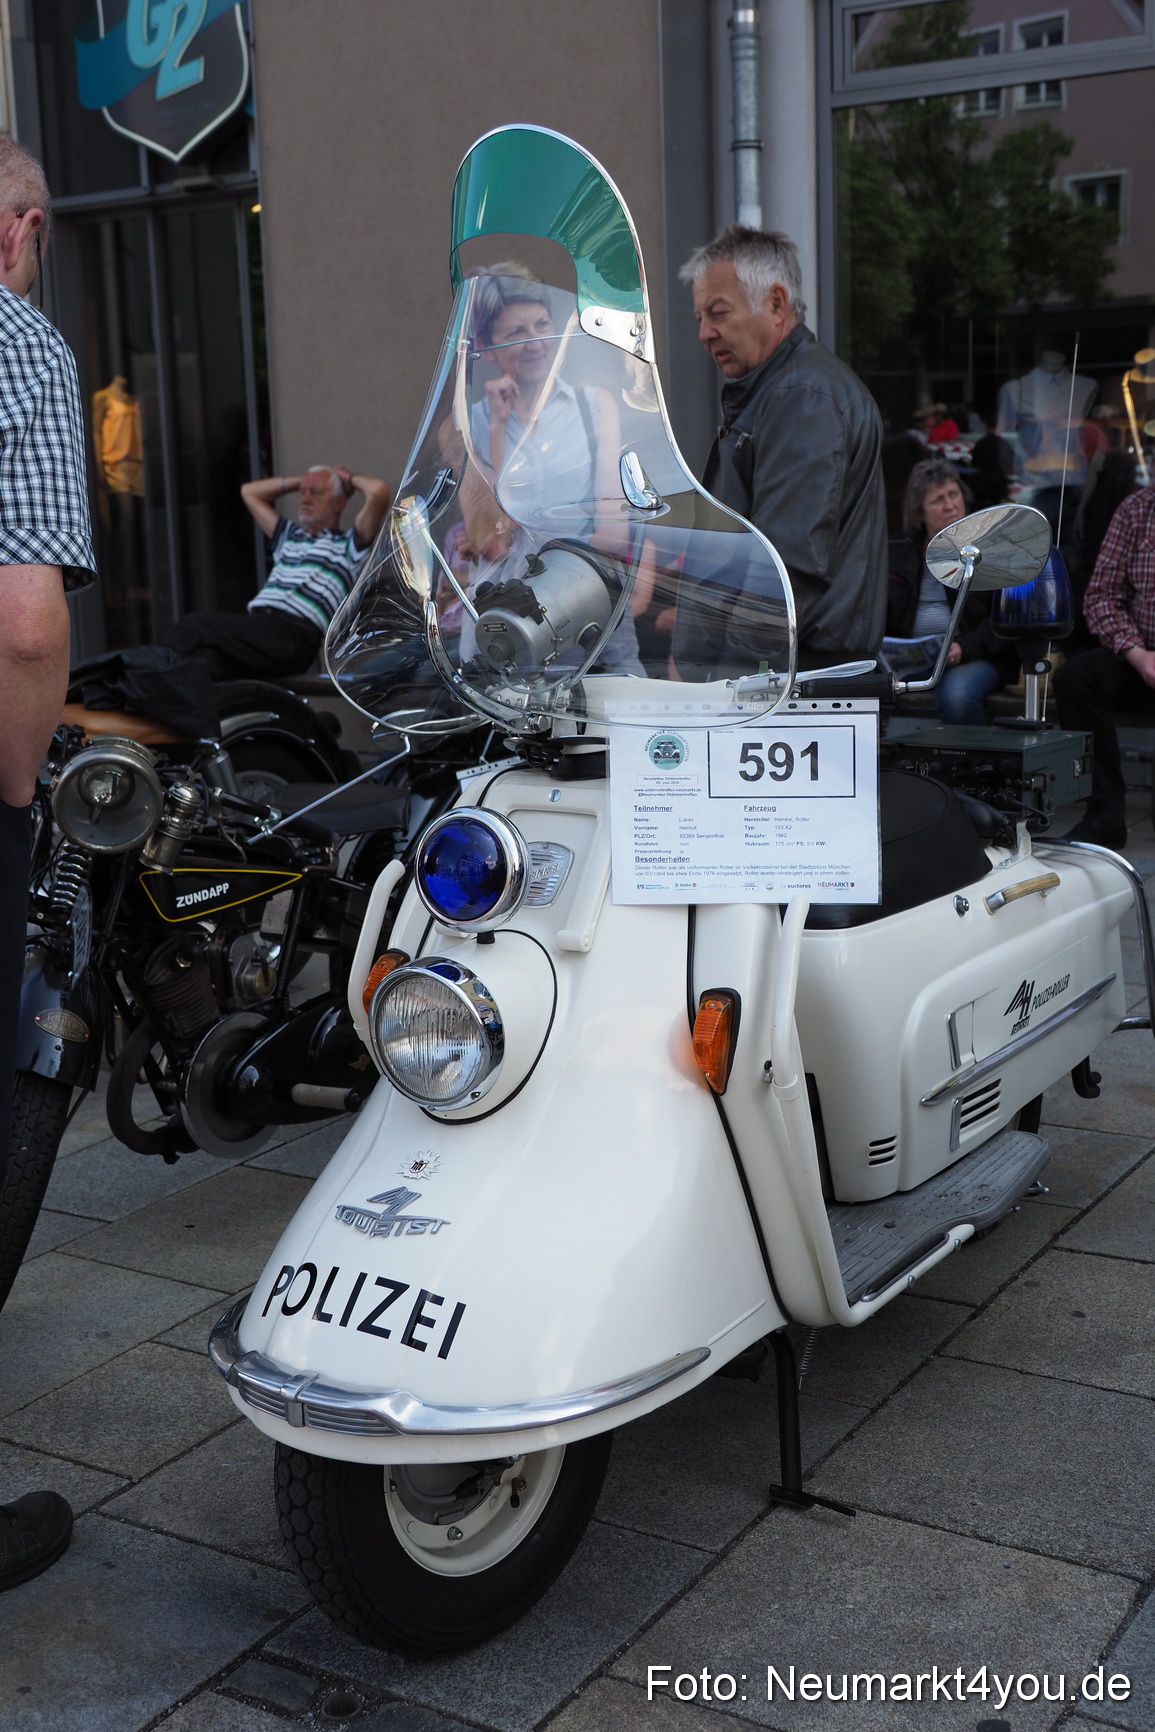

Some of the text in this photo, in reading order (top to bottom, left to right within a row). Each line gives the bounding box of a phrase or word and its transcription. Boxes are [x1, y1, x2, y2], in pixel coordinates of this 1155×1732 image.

[738, 741, 819, 782] 591
[635, 855, 691, 863] Besonderheiten
[1031, 973, 1070, 1013] POLIZEI-ROLLER
[335, 1204, 451, 1238] TOURIST
[261, 1262, 466, 1360] POLIZEI
